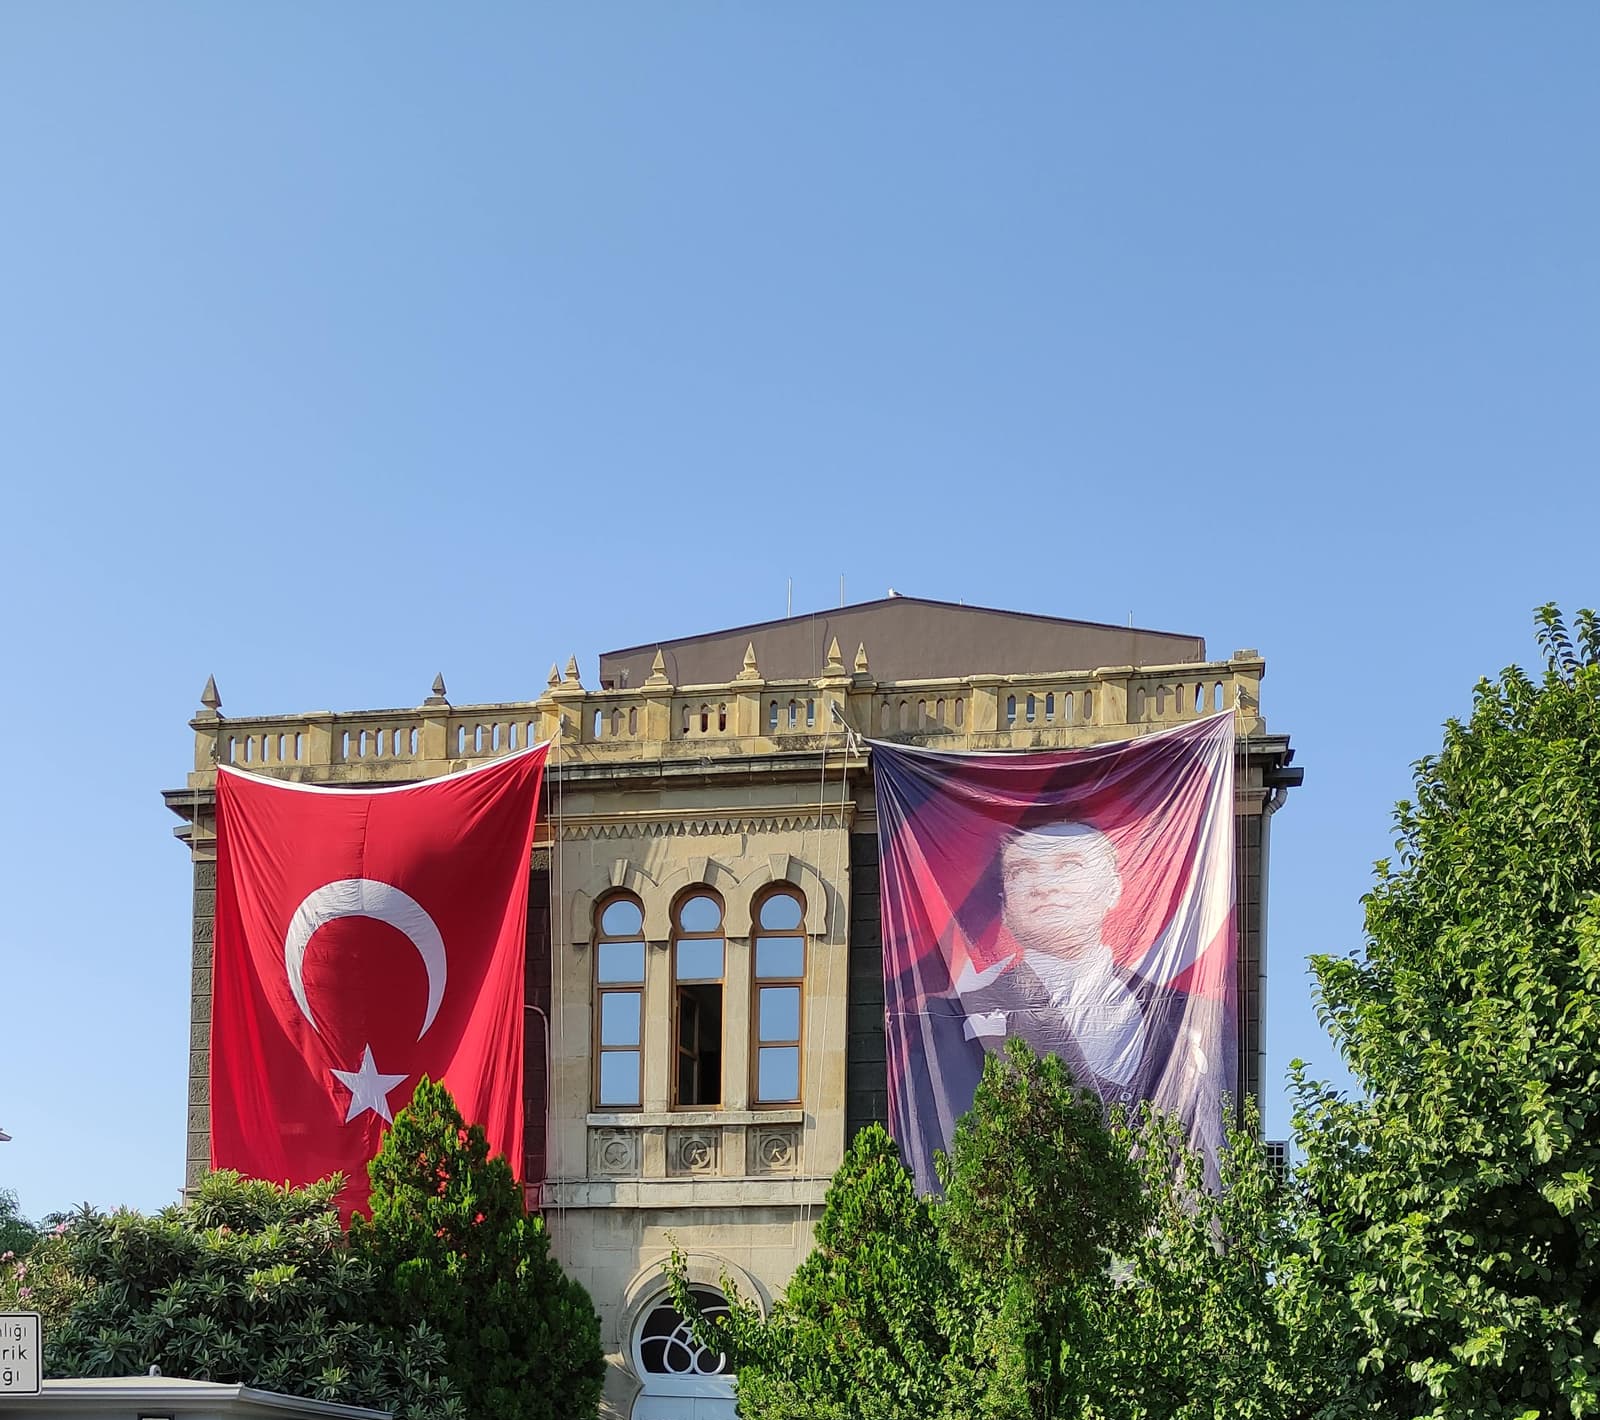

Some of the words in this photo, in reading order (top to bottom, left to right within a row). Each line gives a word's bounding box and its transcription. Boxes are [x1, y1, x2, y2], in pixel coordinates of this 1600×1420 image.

[0, 1322, 27, 1341] lığı
[2, 1344, 28, 1361] rik
[2, 1367, 20, 1386] ğı
